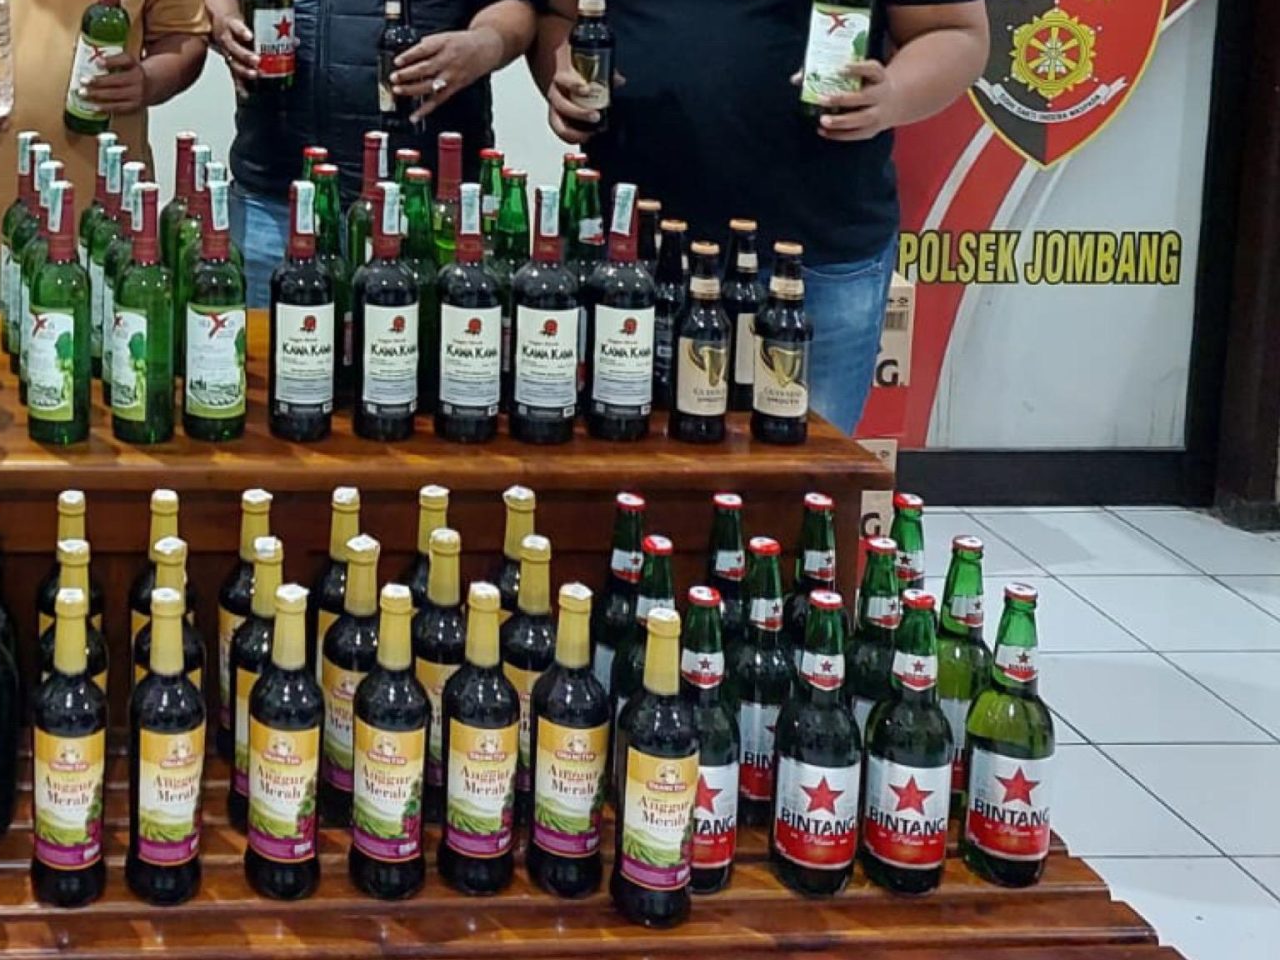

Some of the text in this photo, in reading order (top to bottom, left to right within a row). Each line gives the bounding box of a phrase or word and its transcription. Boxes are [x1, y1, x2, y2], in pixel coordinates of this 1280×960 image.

[899, 230, 1183, 285] POLSEK JOMBANG
[693, 814, 735, 835] TANG
[780, 805, 856, 837] BINTANG
[869, 805, 946, 837] BINTANG
[973, 797, 1051, 827] BINTANG
